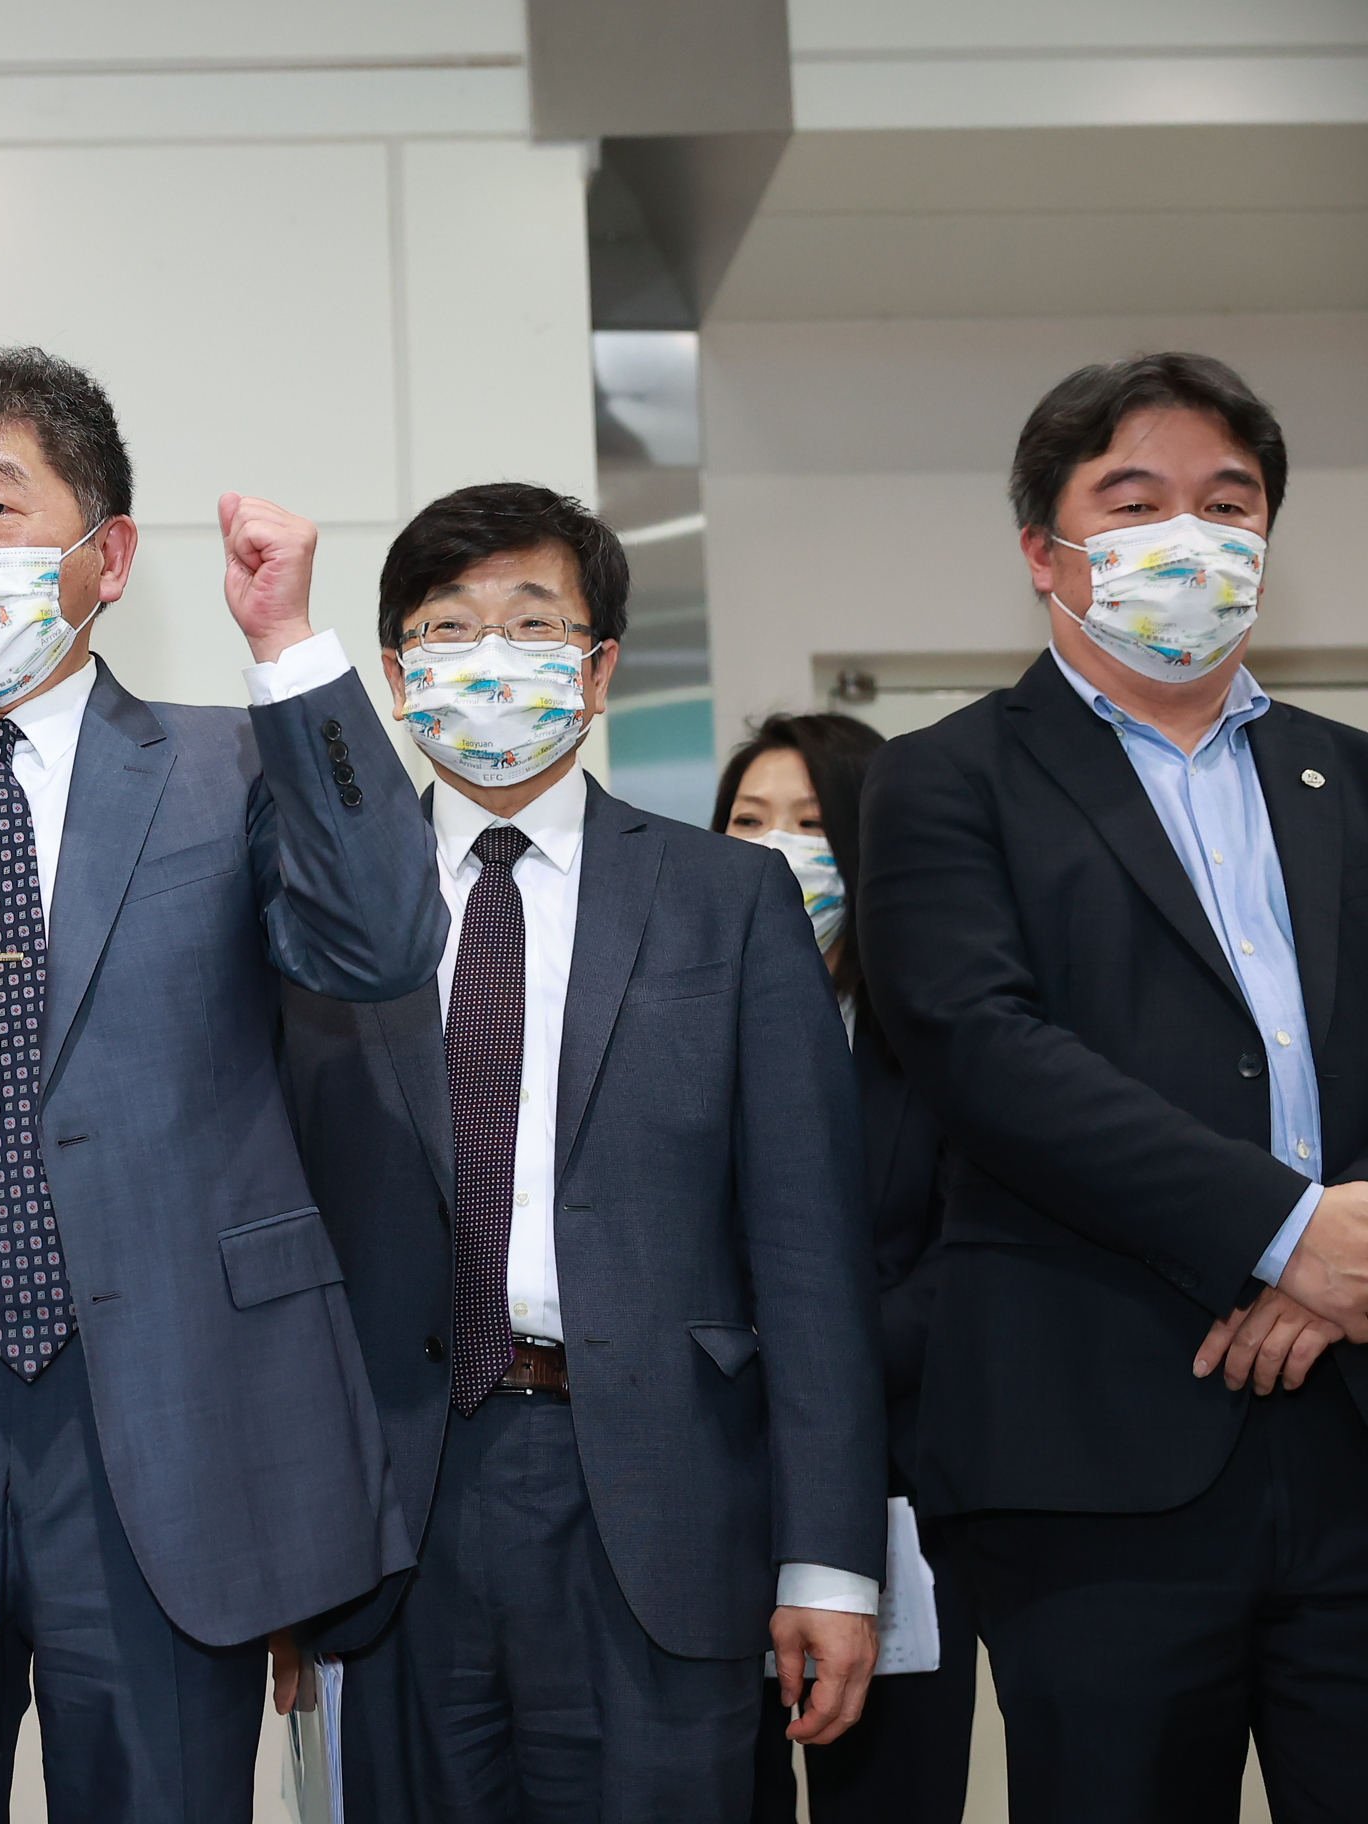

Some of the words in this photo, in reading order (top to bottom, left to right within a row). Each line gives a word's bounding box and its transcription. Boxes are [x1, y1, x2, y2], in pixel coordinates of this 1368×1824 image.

[459, 669, 491, 681] Taoyuan
[539, 697, 568, 706] Taoyuan
[533, 727, 558, 740] Arrival
[462, 739, 493, 749] Taoyuan
